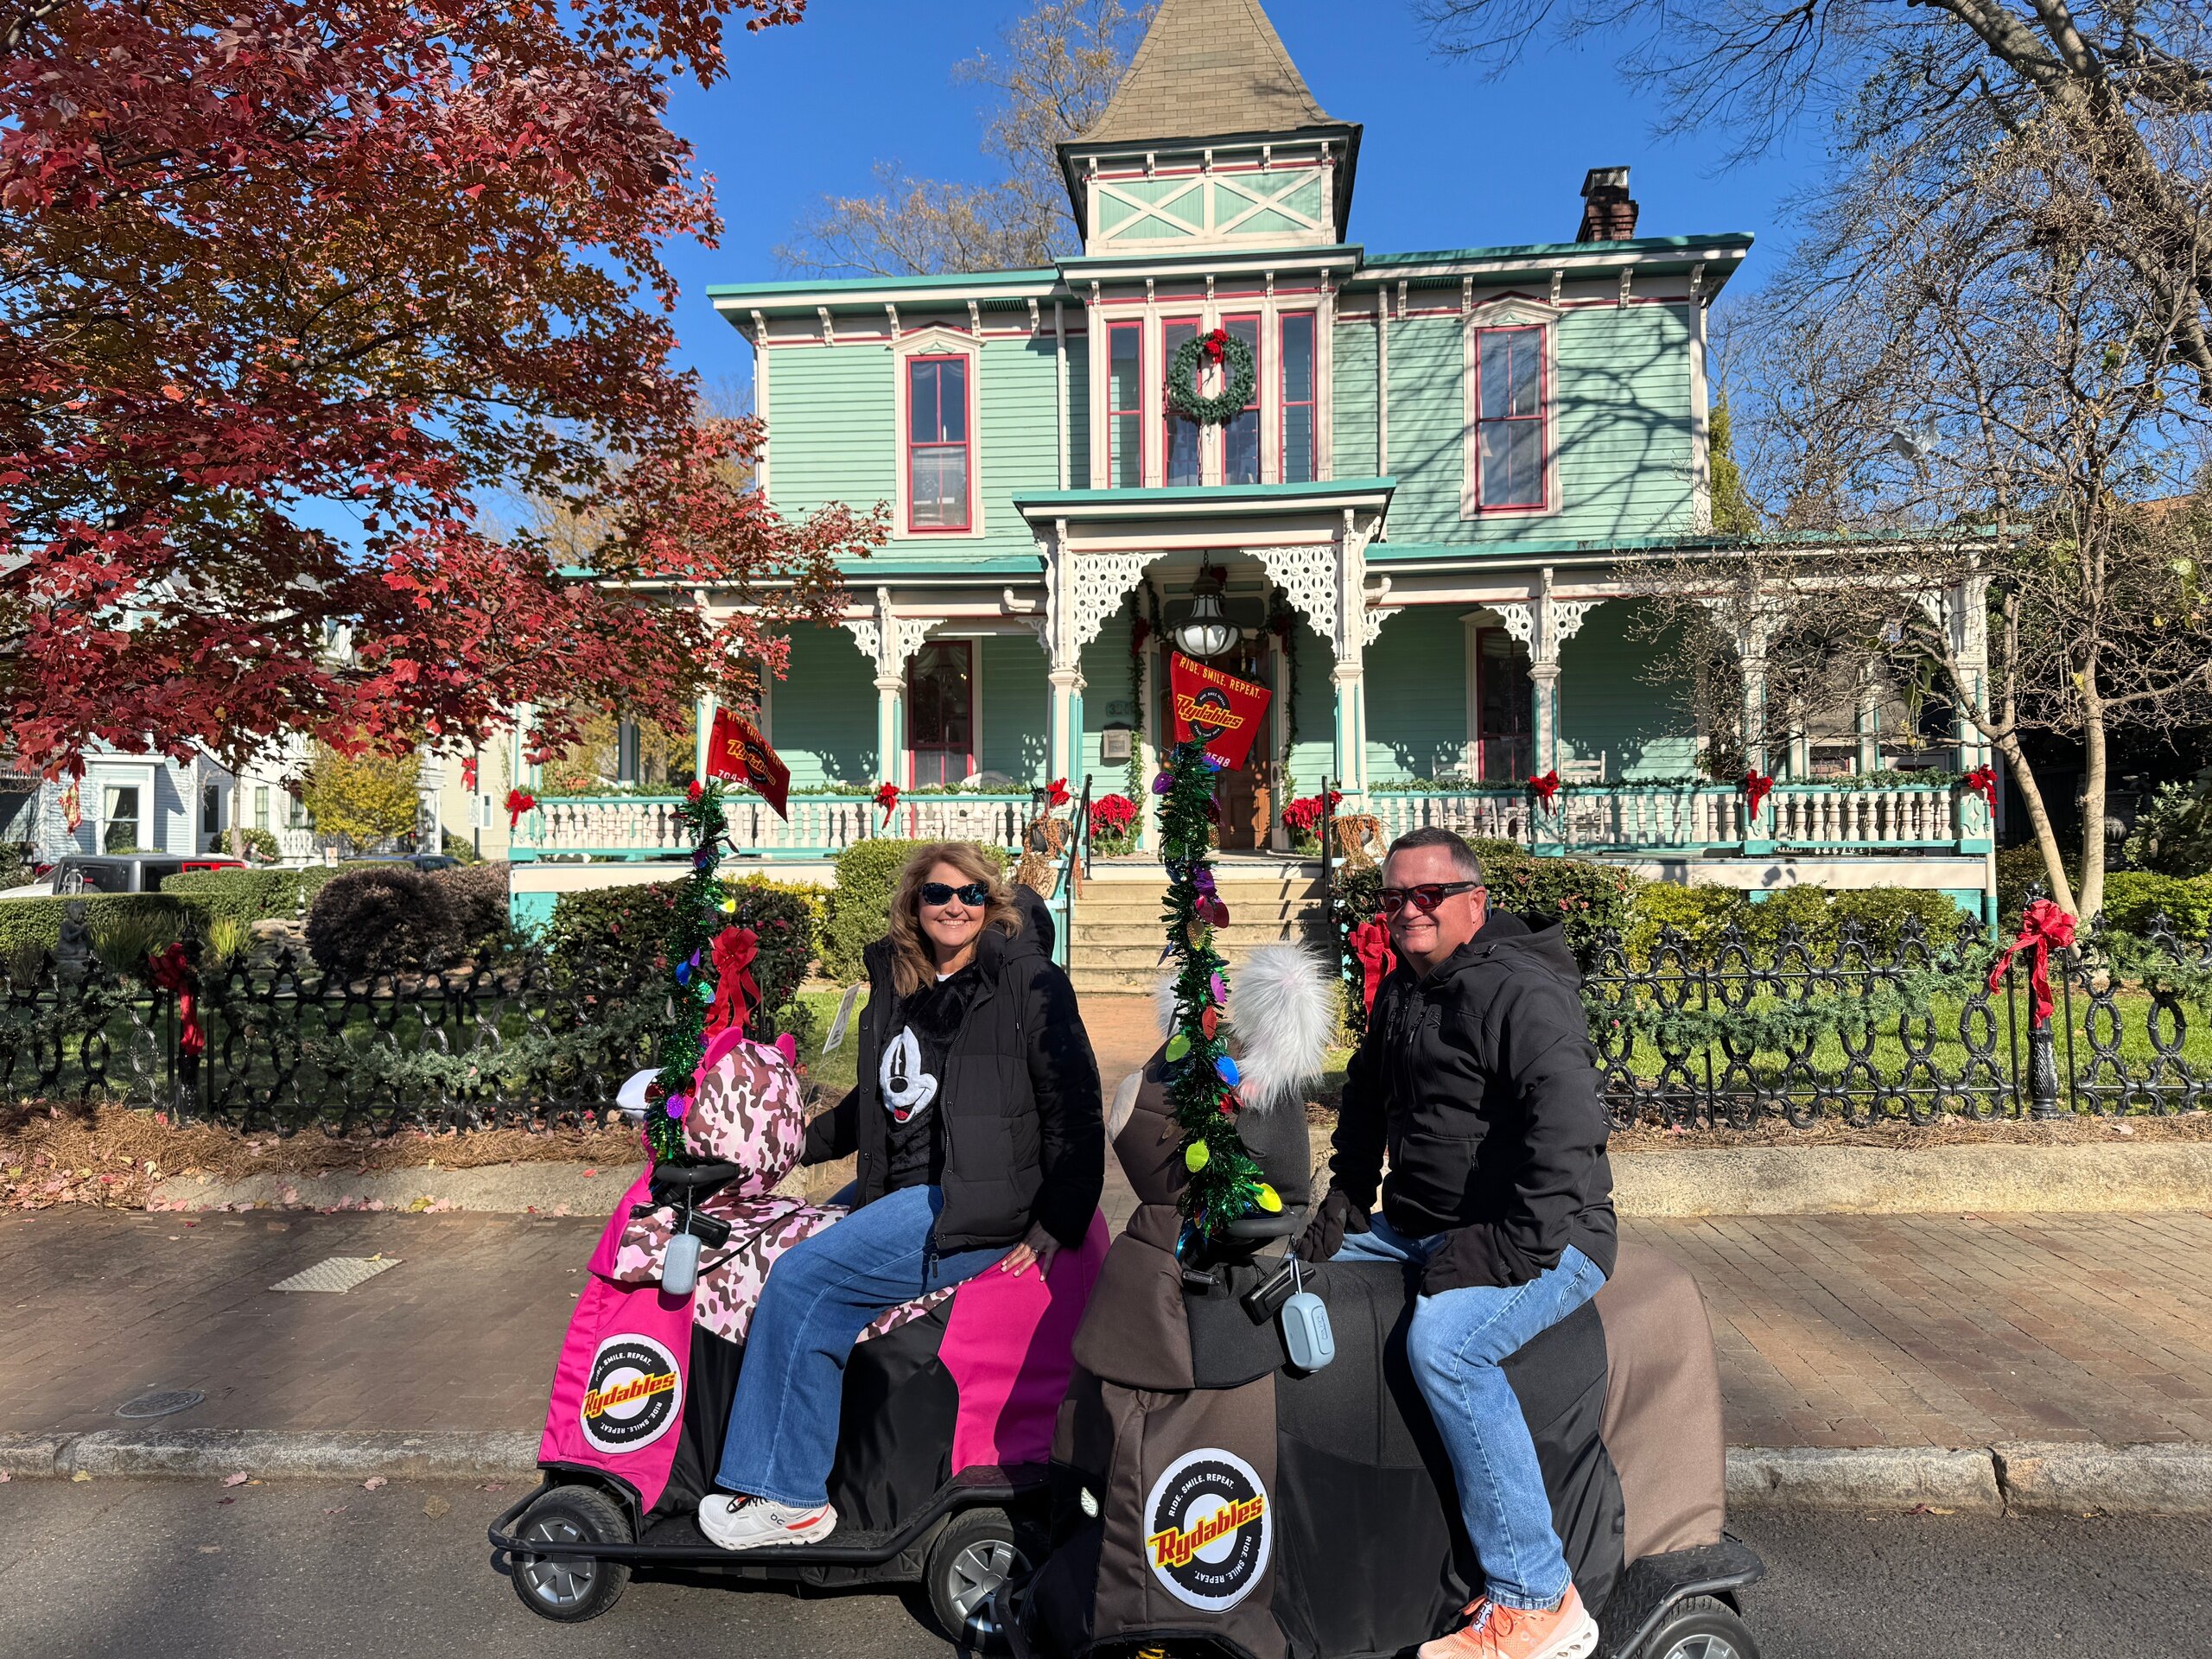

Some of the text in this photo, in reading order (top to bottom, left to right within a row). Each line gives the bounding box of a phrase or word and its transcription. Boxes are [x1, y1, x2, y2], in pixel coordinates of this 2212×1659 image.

[1179, 657, 1261, 699] RIDE. SMILE. REPEAT.
[1177, 694, 1244, 729] Rydables
[603, 1352, 626, 1366] SMILE.
[627, 1351, 652, 1366] REPEAT.
[582, 1372, 677, 1419] Rydables
[600, 1402, 663, 1434] RIDE. SMILE. REPEAT.
[1168, 1473, 1235, 1517] RIDE. SMILE. REPEAT.
[1147, 1496, 1263, 1568] Rydables
[1194, 1535, 1252, 1584] RIDE. SMILE. REPEAT.
